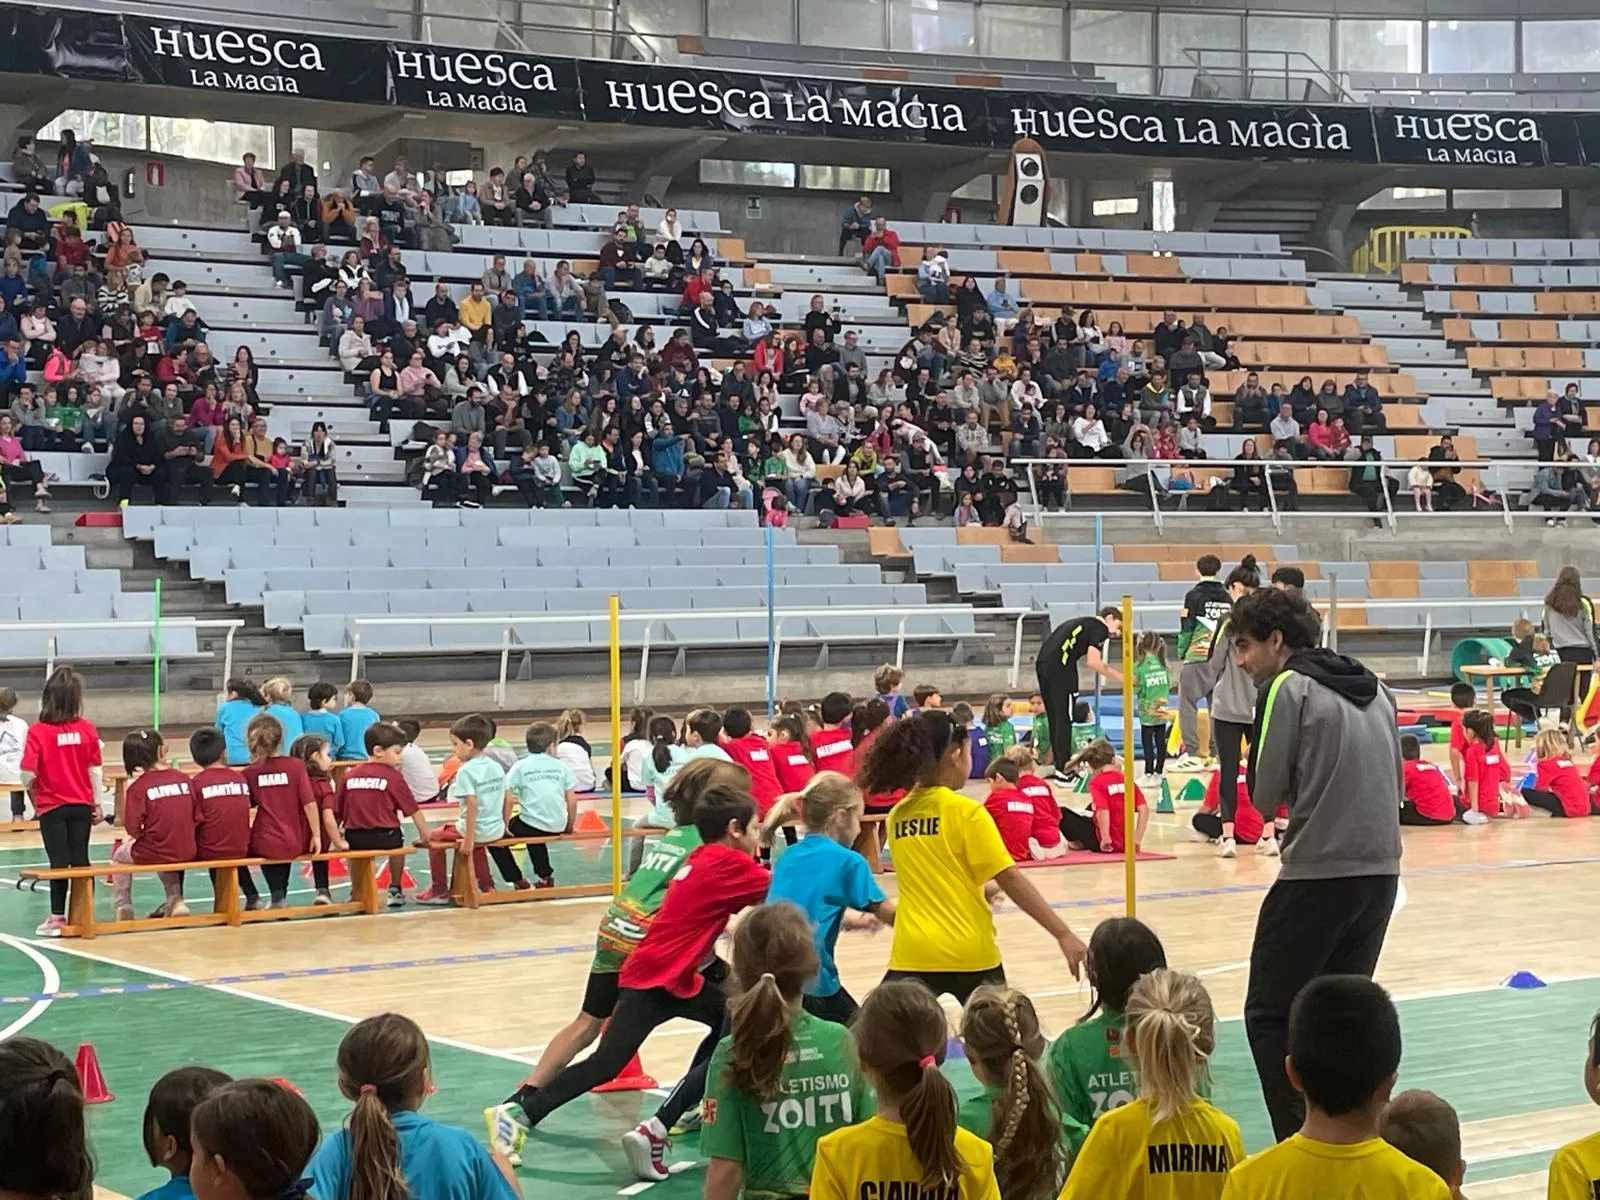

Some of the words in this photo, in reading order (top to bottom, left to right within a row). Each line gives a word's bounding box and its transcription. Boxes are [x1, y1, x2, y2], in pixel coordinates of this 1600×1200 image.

[147, 783, 180, 801] OLIVIA
[346, 777, 388, 791] MARCELO
[895, 817, 940, 840] LESLIE
[780, 1073, 850, 1094] LETISMO
[760, 1090, 853, 1134] ZOITI
[1148, 1143, 1228, 1174] MIRINA
